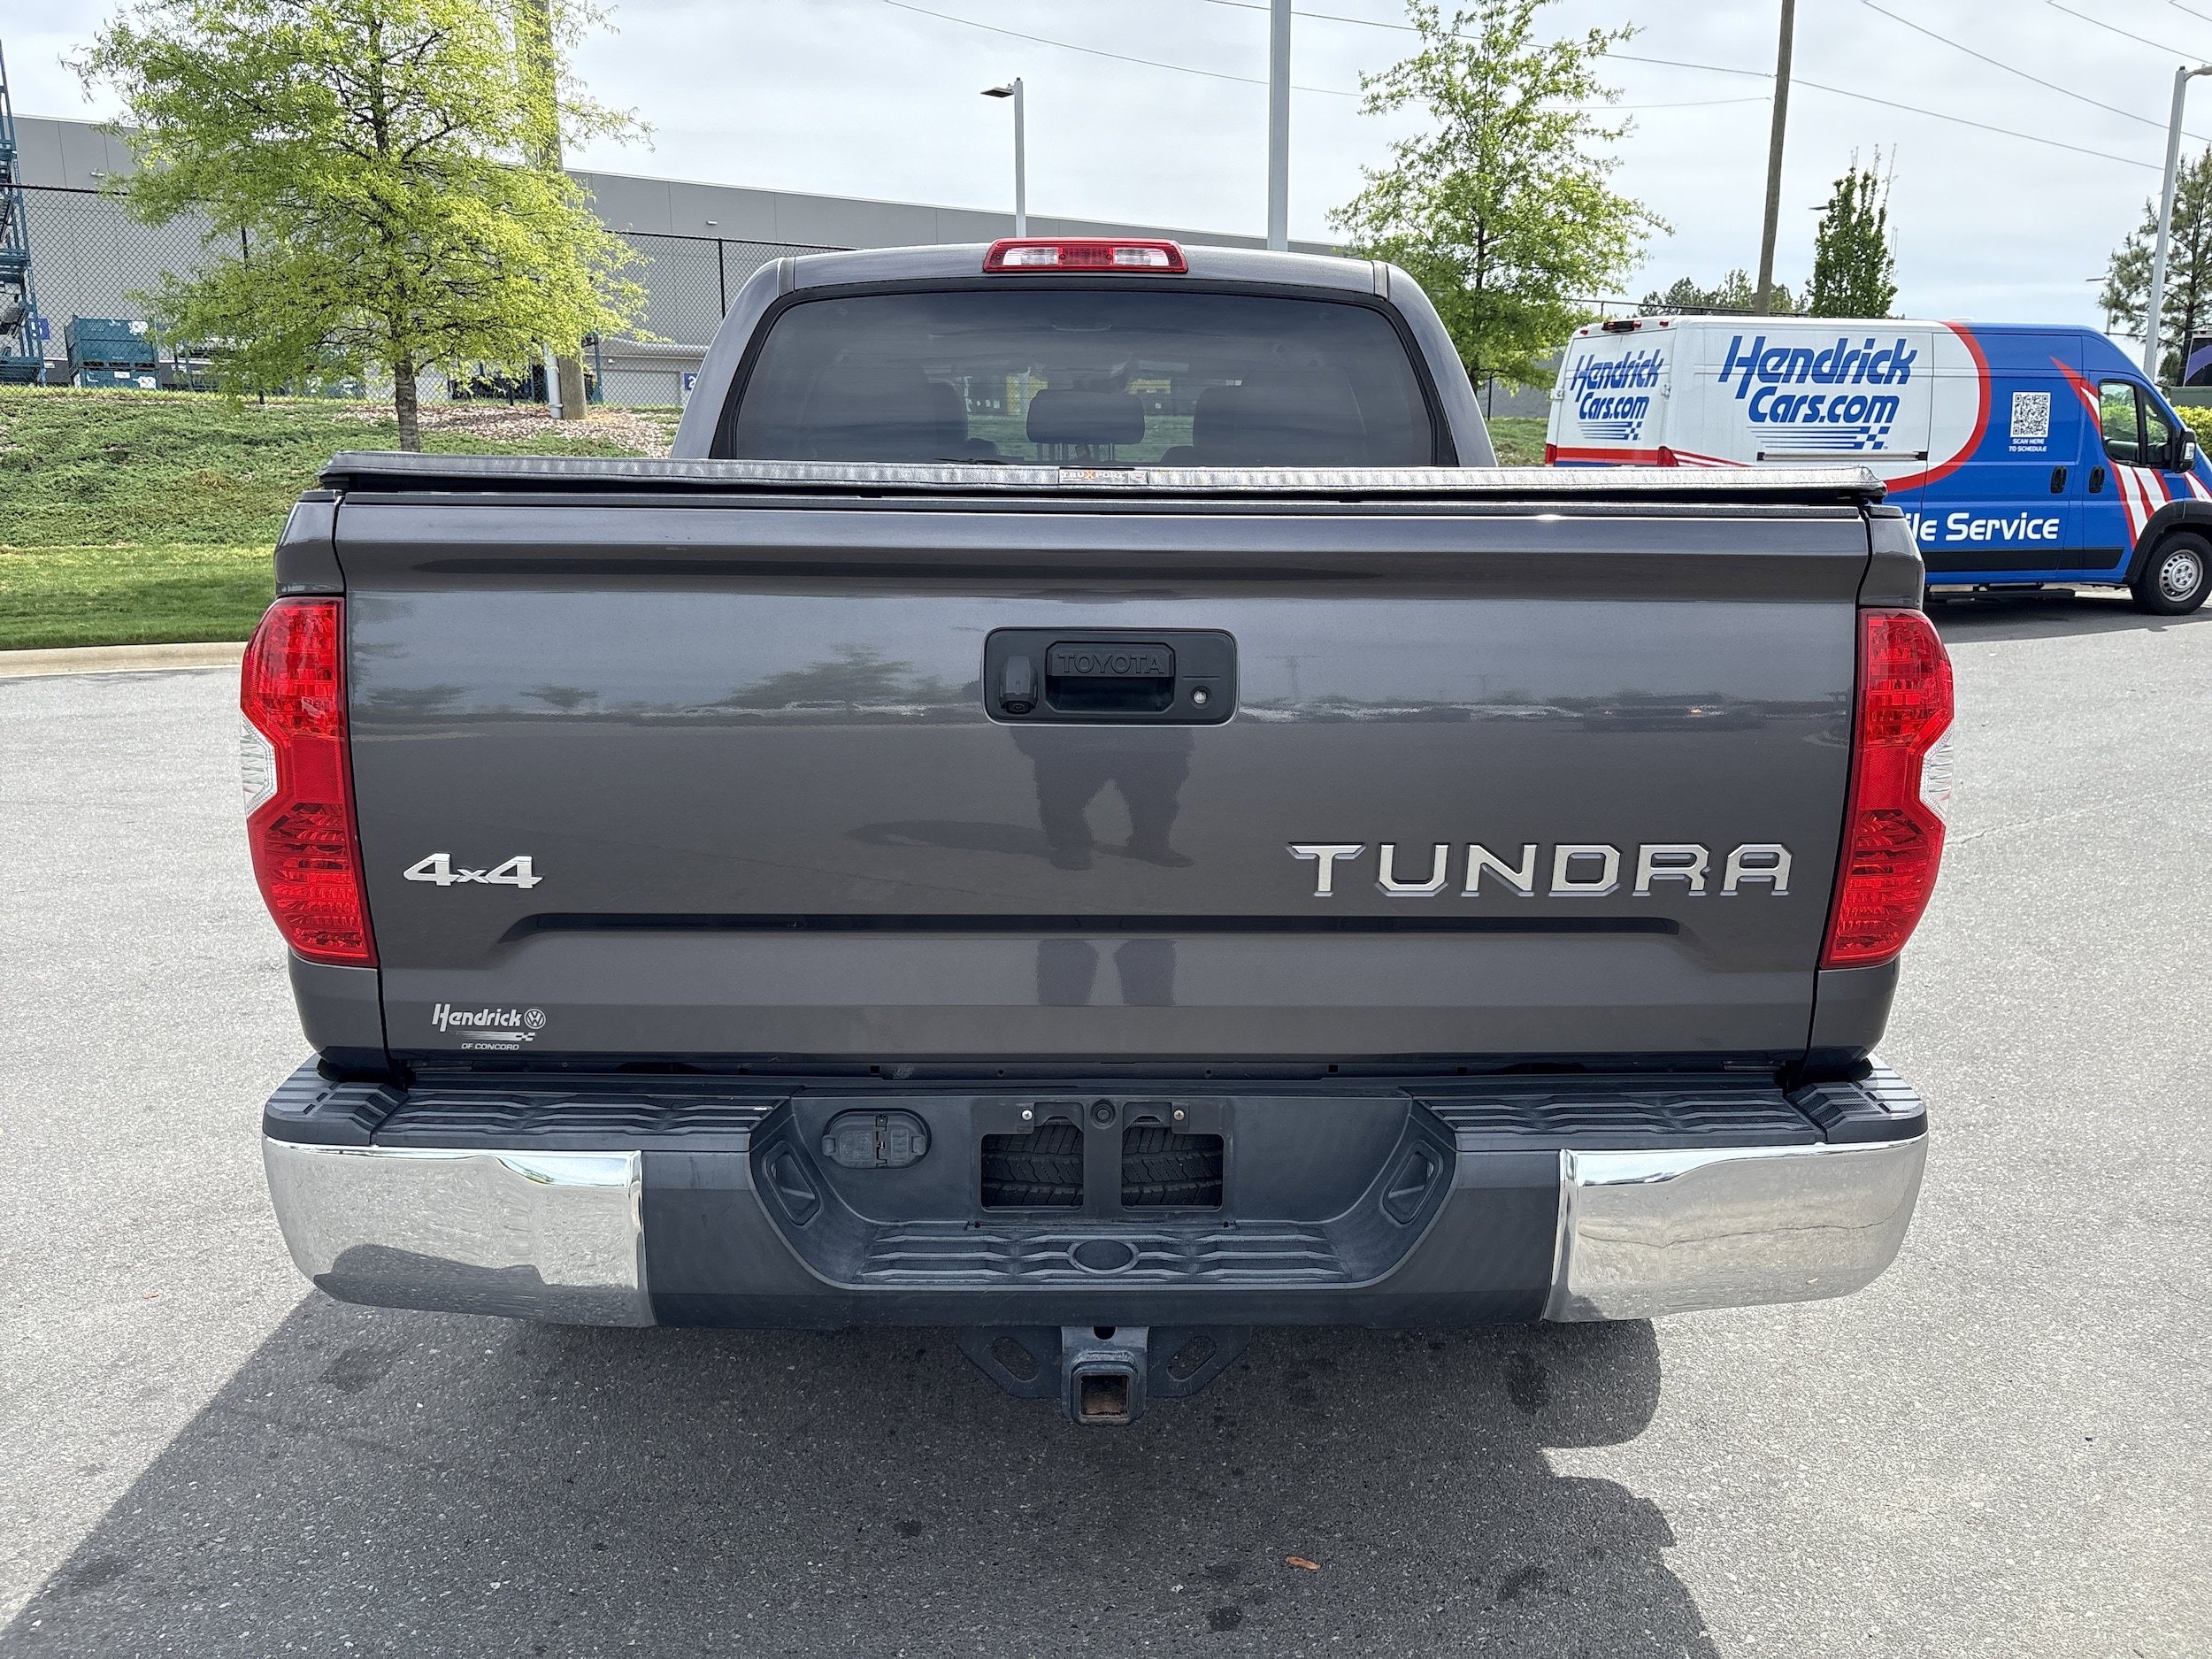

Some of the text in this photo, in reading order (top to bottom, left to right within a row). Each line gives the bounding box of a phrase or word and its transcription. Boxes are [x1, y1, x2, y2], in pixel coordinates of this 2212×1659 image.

[1569, 349, 1665, 403] Hendrick
[1717, 335, 1918, 399] Hendrick
[1579, 391, 1650, 419] Cars.com
[1748, 386, 1901, 423] Cars.com
[1061, 470, 1128, 480] TRUXPORT
[1946, 511, 2060, 541] Service
[1058, 652, 1165, 675] TOYOTA
[403, 852, 545, 889] 4x4
[1286, 841, 1794, 897] TUNDRA
[431, 1003, 522, 1033] Hendrick
[474, 1042, 520, 1051] CONCORD
